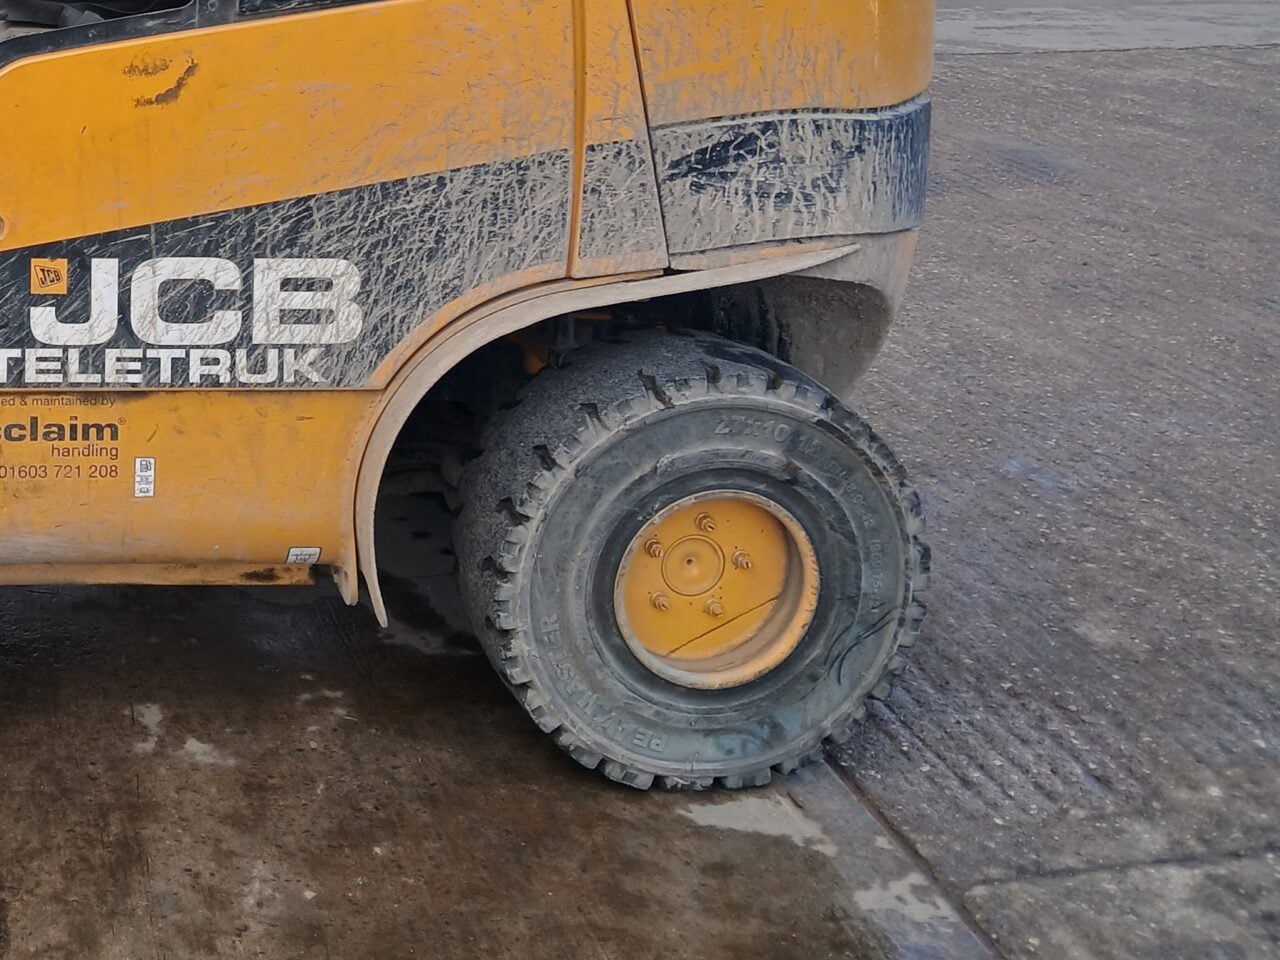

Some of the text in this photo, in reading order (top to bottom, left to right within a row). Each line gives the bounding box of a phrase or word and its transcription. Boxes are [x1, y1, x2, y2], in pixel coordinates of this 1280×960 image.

[29, 256, 364, 346] JCB
[19, 396, 28, 407] &
[31, 395, 97, 407] maintained
[101, 395, 116, 409] by
[51, 444, 119, 460] handling
[54, 464, 81, 479] 721
[88, 464, 119, 479] 208
